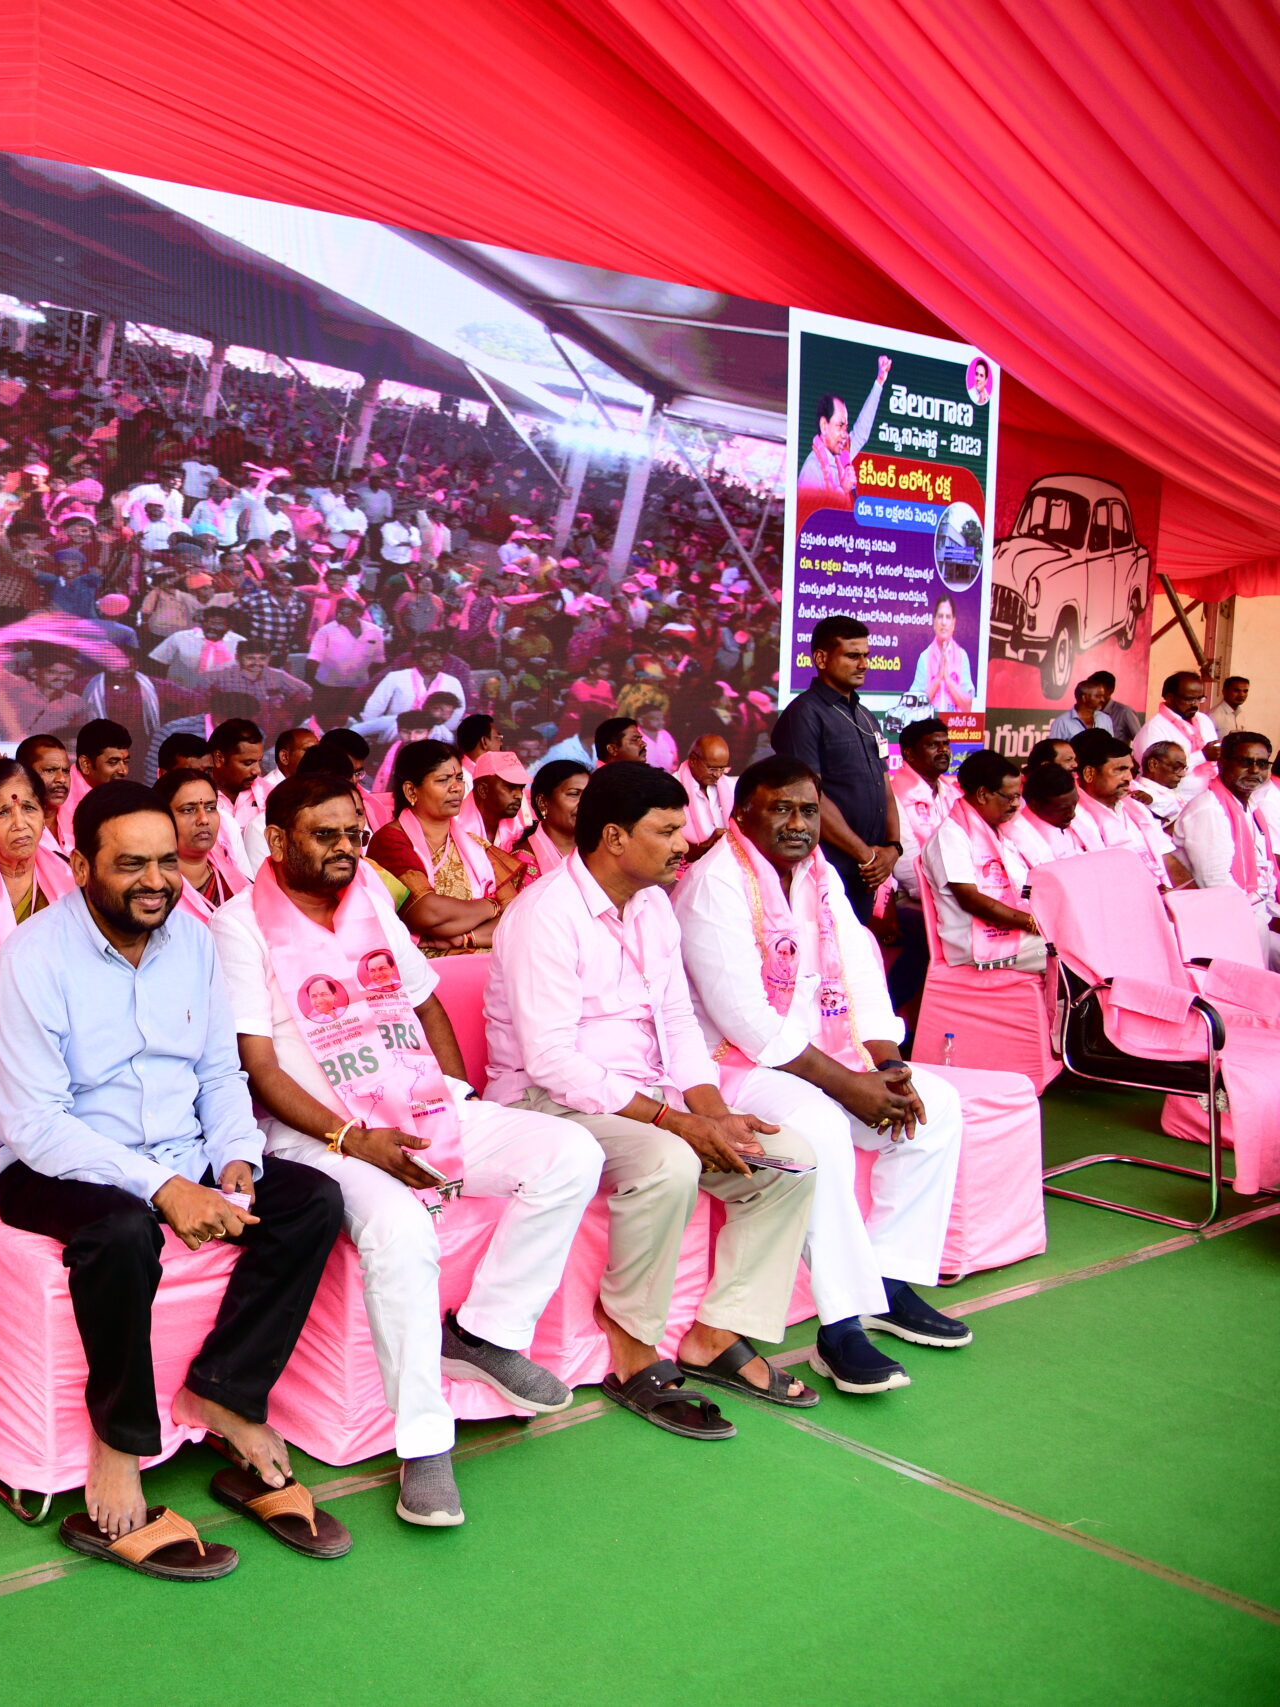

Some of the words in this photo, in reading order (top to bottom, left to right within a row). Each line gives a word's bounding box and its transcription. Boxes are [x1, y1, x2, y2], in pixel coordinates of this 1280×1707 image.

[889, 384, 974, 427] తెలంగాణ
[950, 433, 981, 456] 2023
[859, 459, 896, 488] కేసీఆర్
[898, 469, 934, 501] ఆరోగ్య
[935, 475, 952, 502] రక్ష
[875, 505, 884, 517] 15
[815, 560, 820, 570] 5
[377, 1023, 421, 1050] BRS
[319, 1046, 379, 1087] BRS
